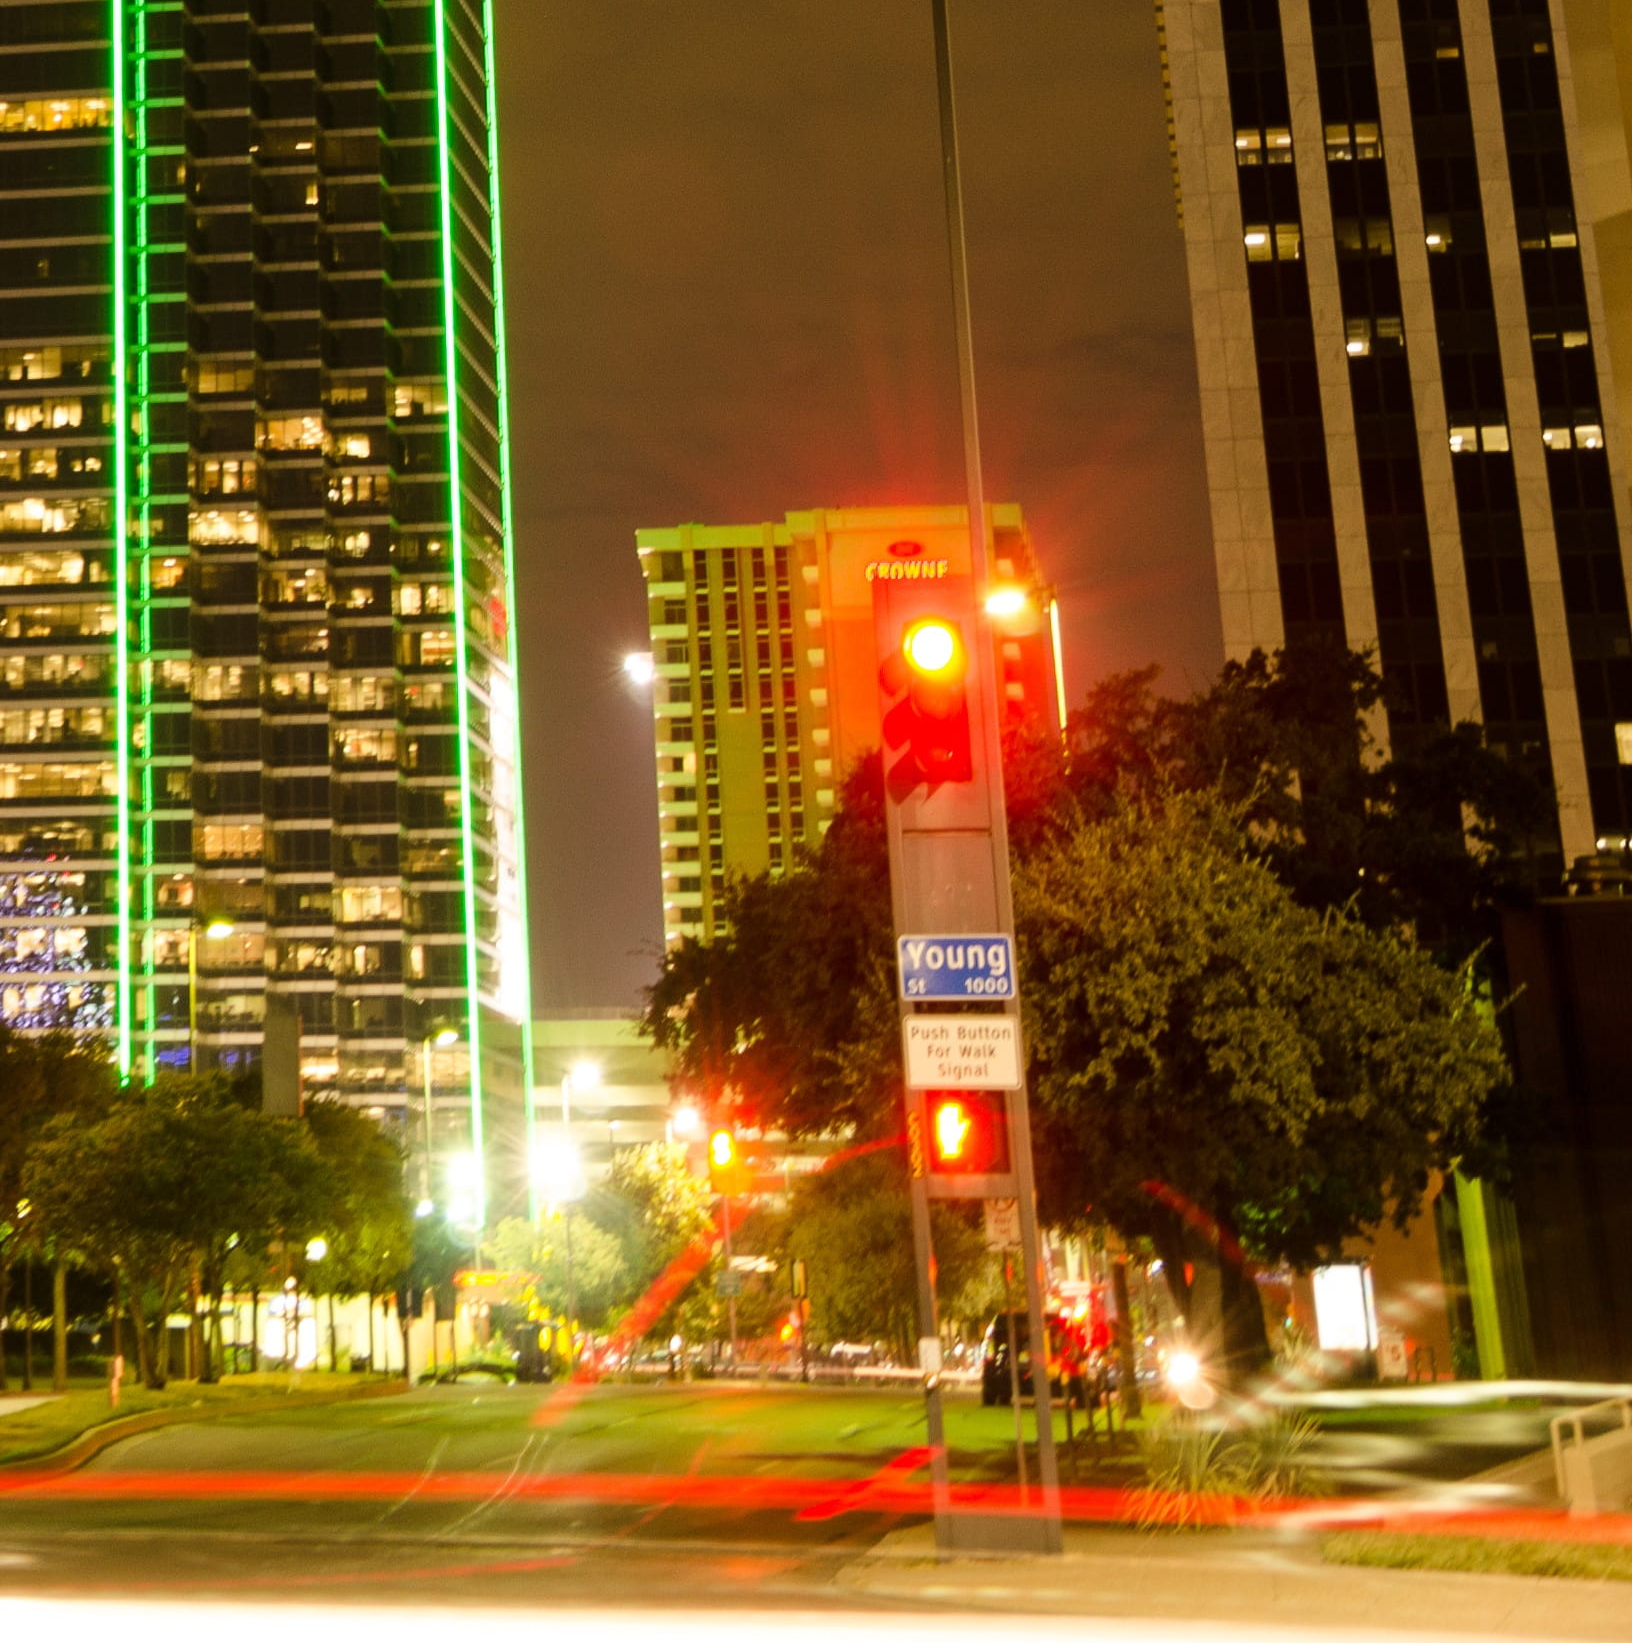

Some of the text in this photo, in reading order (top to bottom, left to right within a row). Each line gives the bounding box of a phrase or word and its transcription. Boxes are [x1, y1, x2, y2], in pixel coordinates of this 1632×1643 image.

[907, 942, 1006, 976] Young
[908, 978, 1008, 994] St 1000
[911, 1026, 1011, 1040] Push Button
[927, 1045, 996, 1058] For Walk
[938, 1063, 988, 1080] Signal
